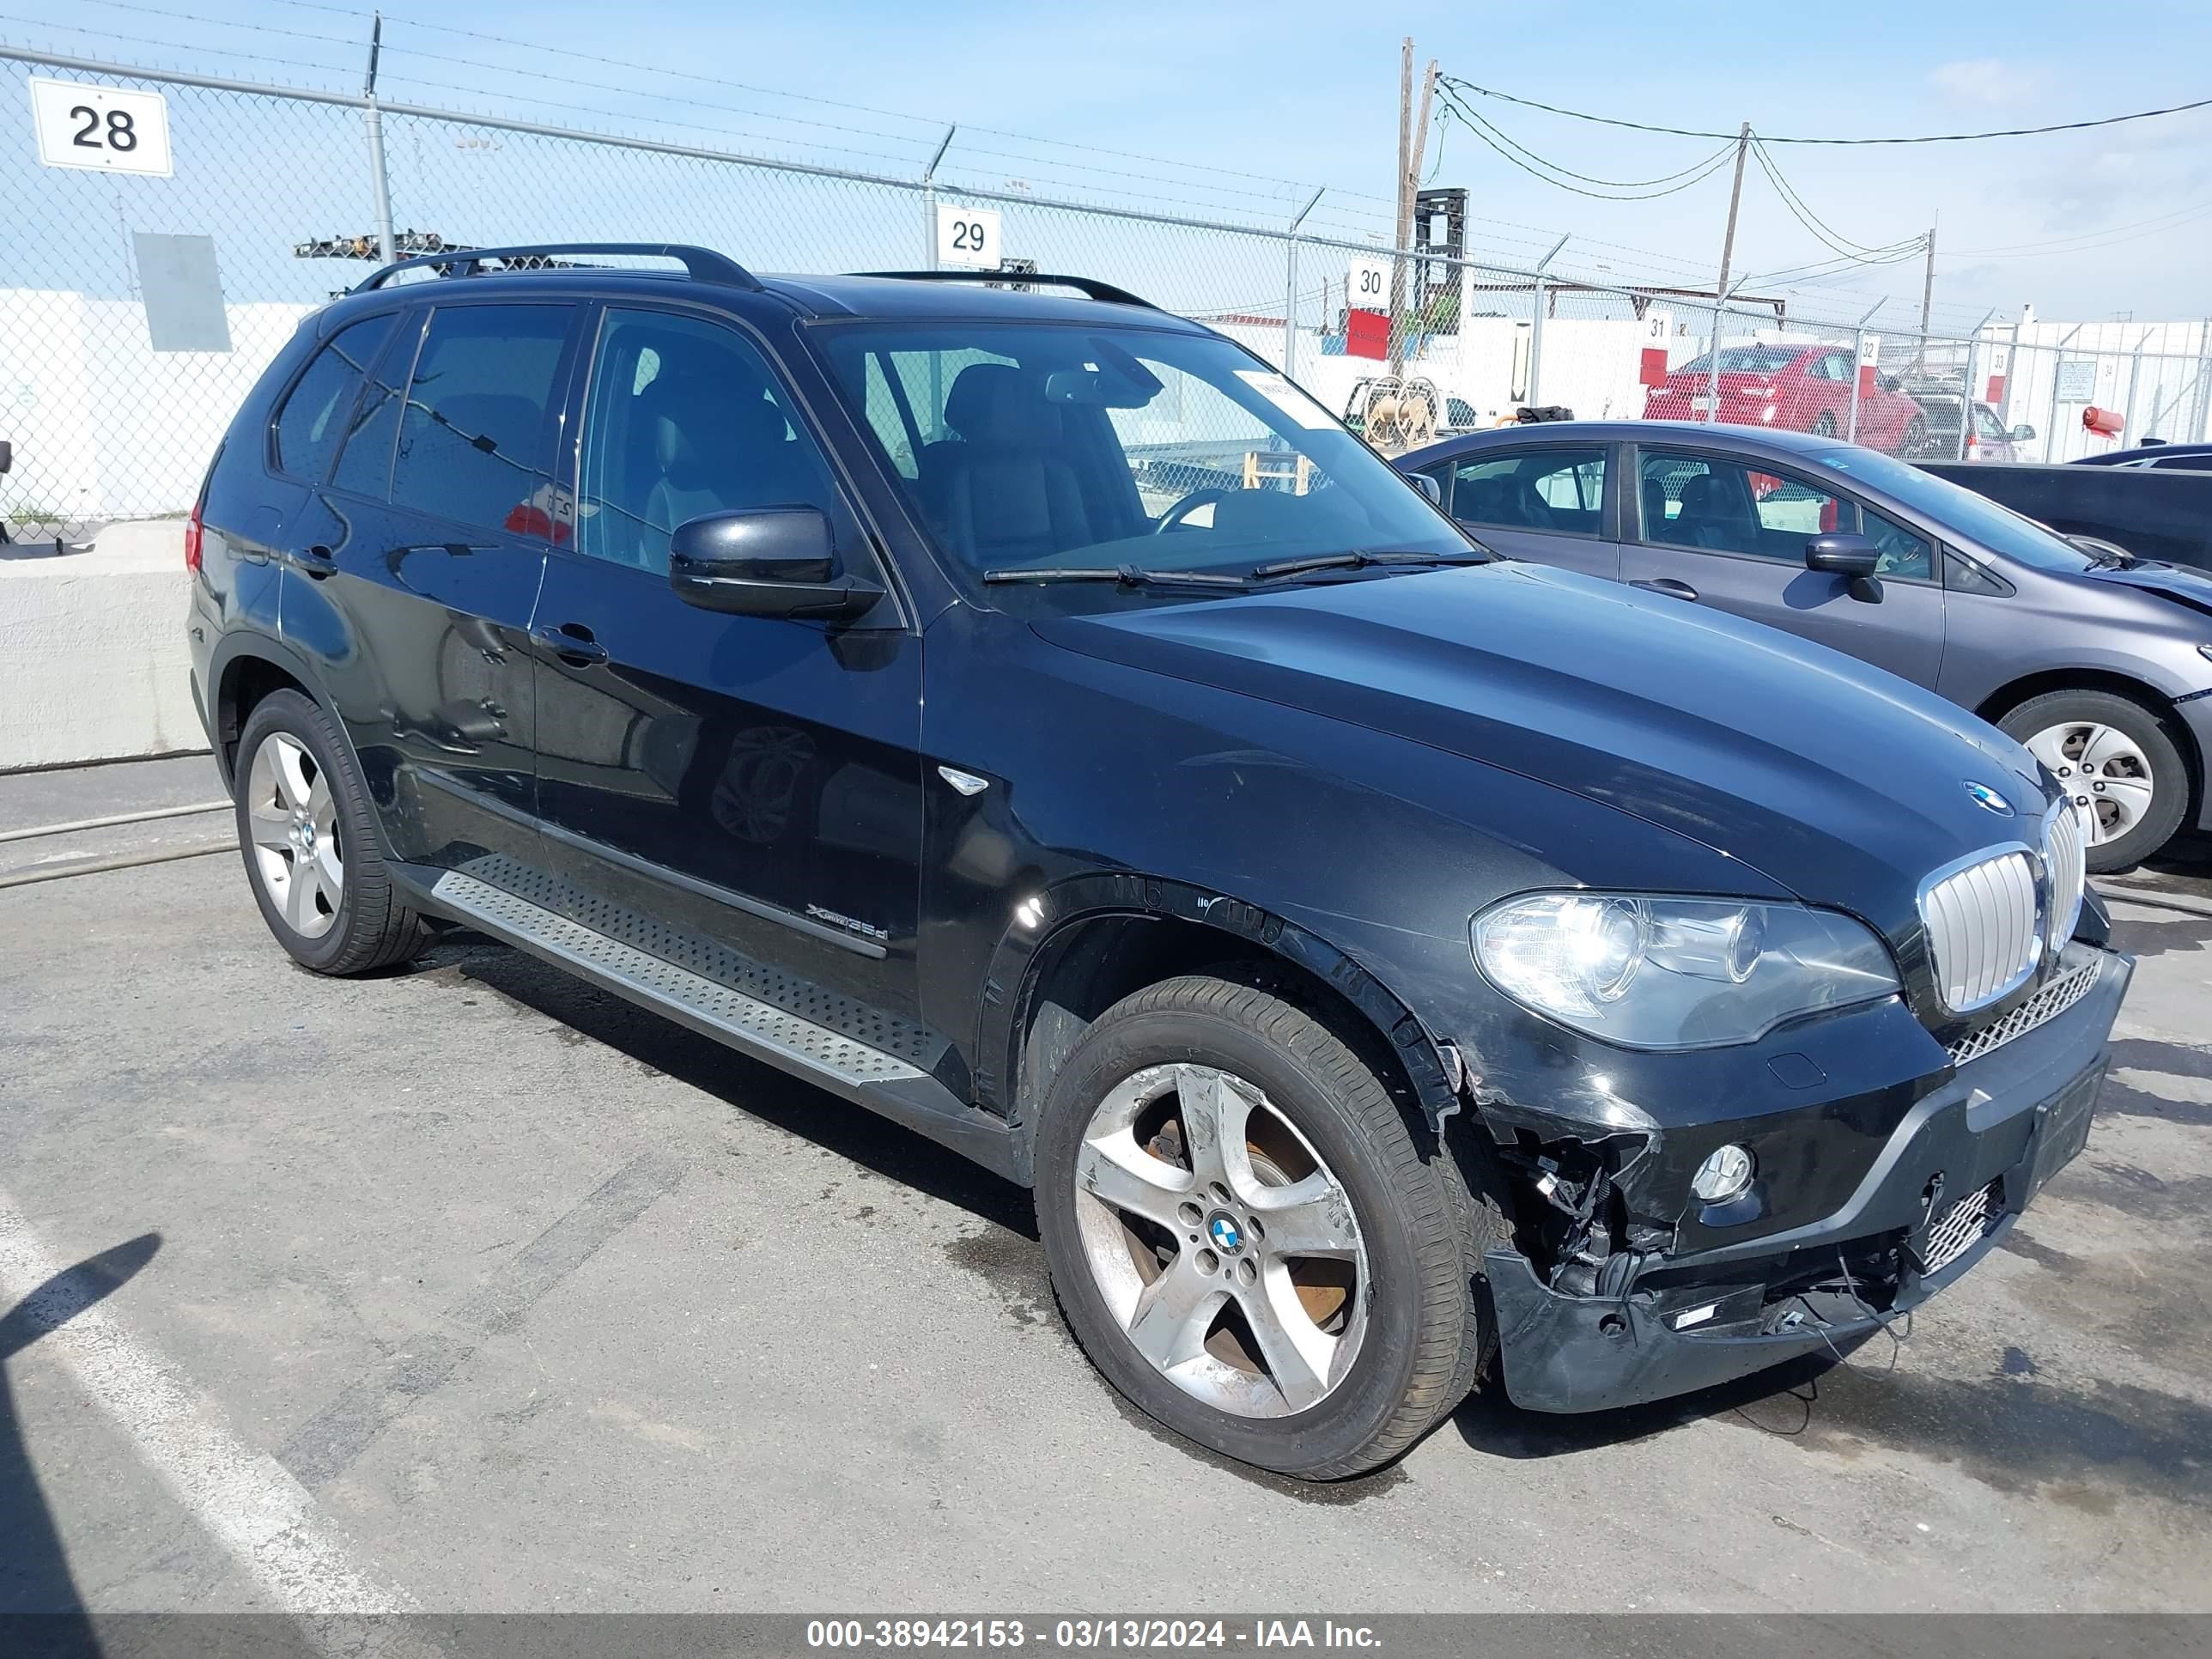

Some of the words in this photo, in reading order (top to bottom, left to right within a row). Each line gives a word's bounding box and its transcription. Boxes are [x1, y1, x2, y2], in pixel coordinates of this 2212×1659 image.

[70, 106, 137, 152] 28
[953, 221, 984, 252] 29
[1360, 270, 1381, 295] 30
[1650, 318, 1665, 338] 31
[1863, 342, 1874, 358] 32
[1994, 355, 2004, 370] 33
